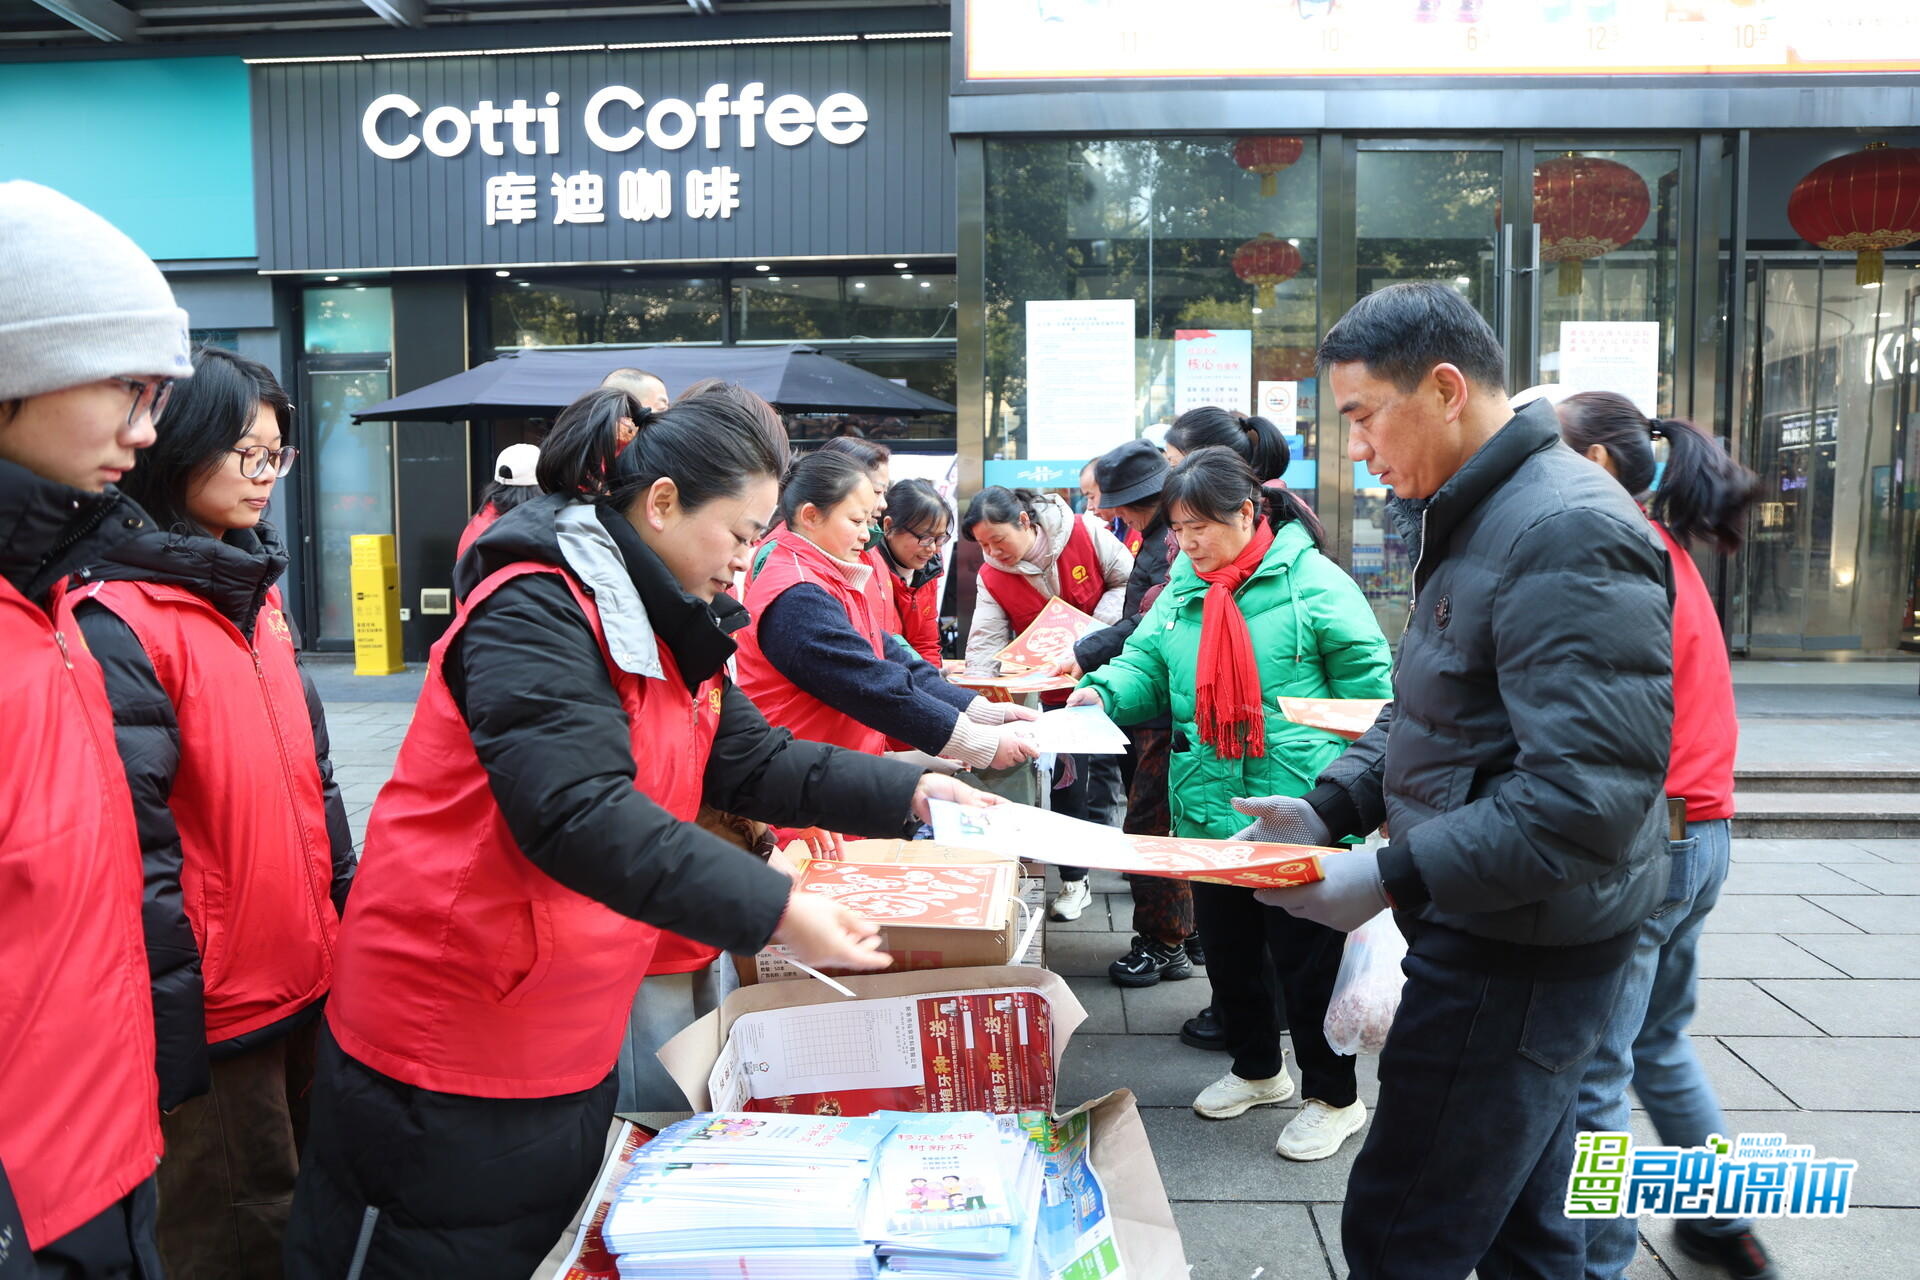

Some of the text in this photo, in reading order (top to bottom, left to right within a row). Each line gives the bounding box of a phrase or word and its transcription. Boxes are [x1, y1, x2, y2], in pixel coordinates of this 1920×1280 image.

[362, 82, 869, 160] Cotti Coffee
[485, 166, 741, 226] 库迪咖啡
